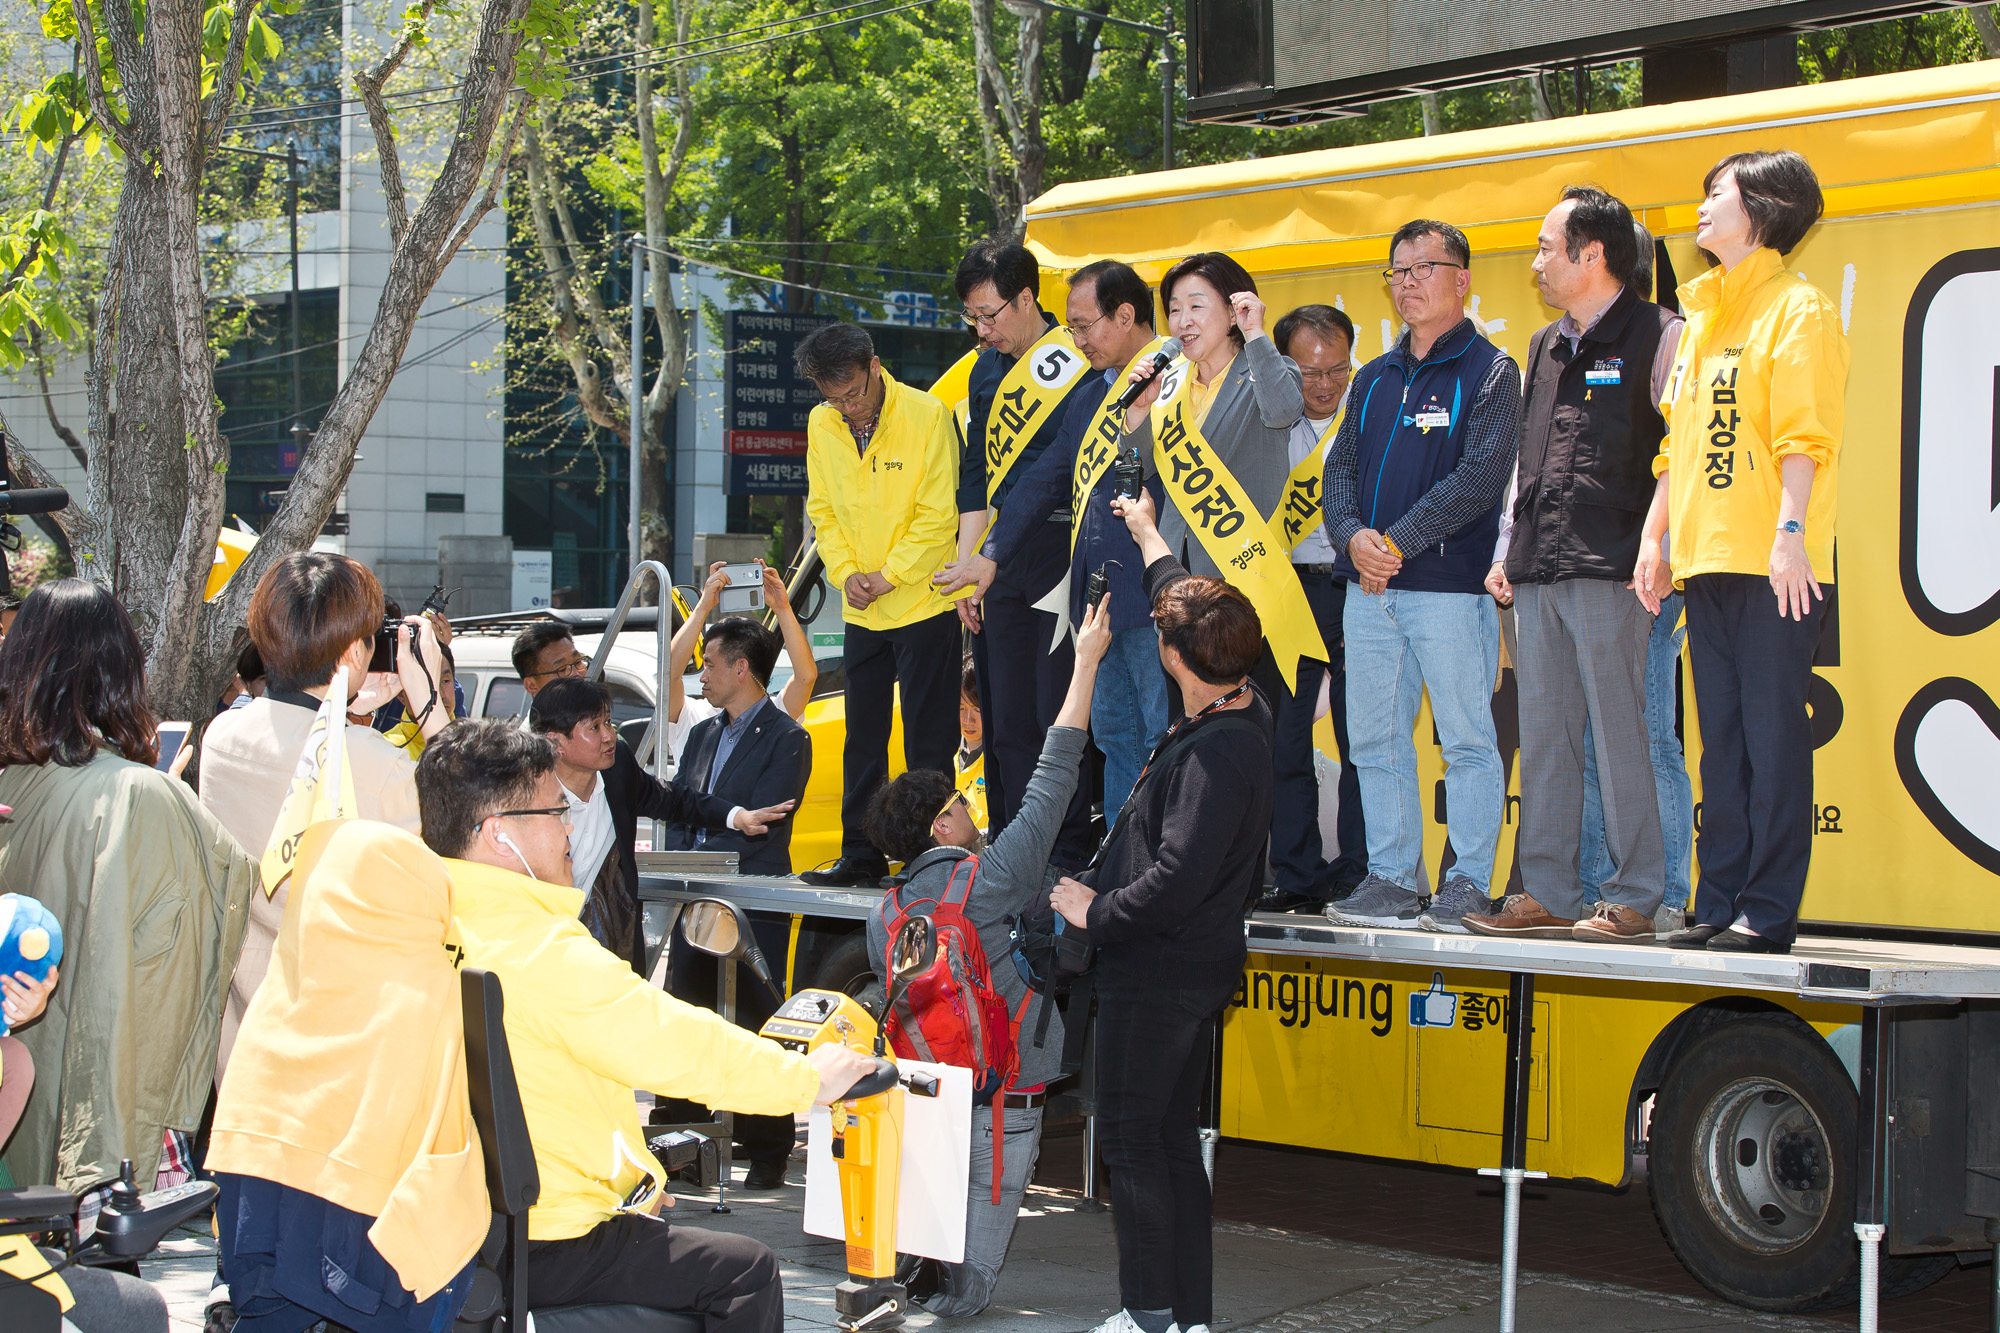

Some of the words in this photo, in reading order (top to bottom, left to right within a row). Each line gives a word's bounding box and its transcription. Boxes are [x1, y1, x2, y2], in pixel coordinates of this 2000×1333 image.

[736, 363, 778, 379] 치과병원
[1037, 349, 1071, 381] 5
[736, 387, 786, 403] 어린이병원
[1162, 370, 1178, 400] 5
[737, 411, 768, 426] 암병원
[1705, 368, 1741, 489] 심상정
[745, 436, 793, 449] 응급의료센터
[1158, 400, 1245, 538] 심상정
[1230, 541, 1267, 570] 정의당
